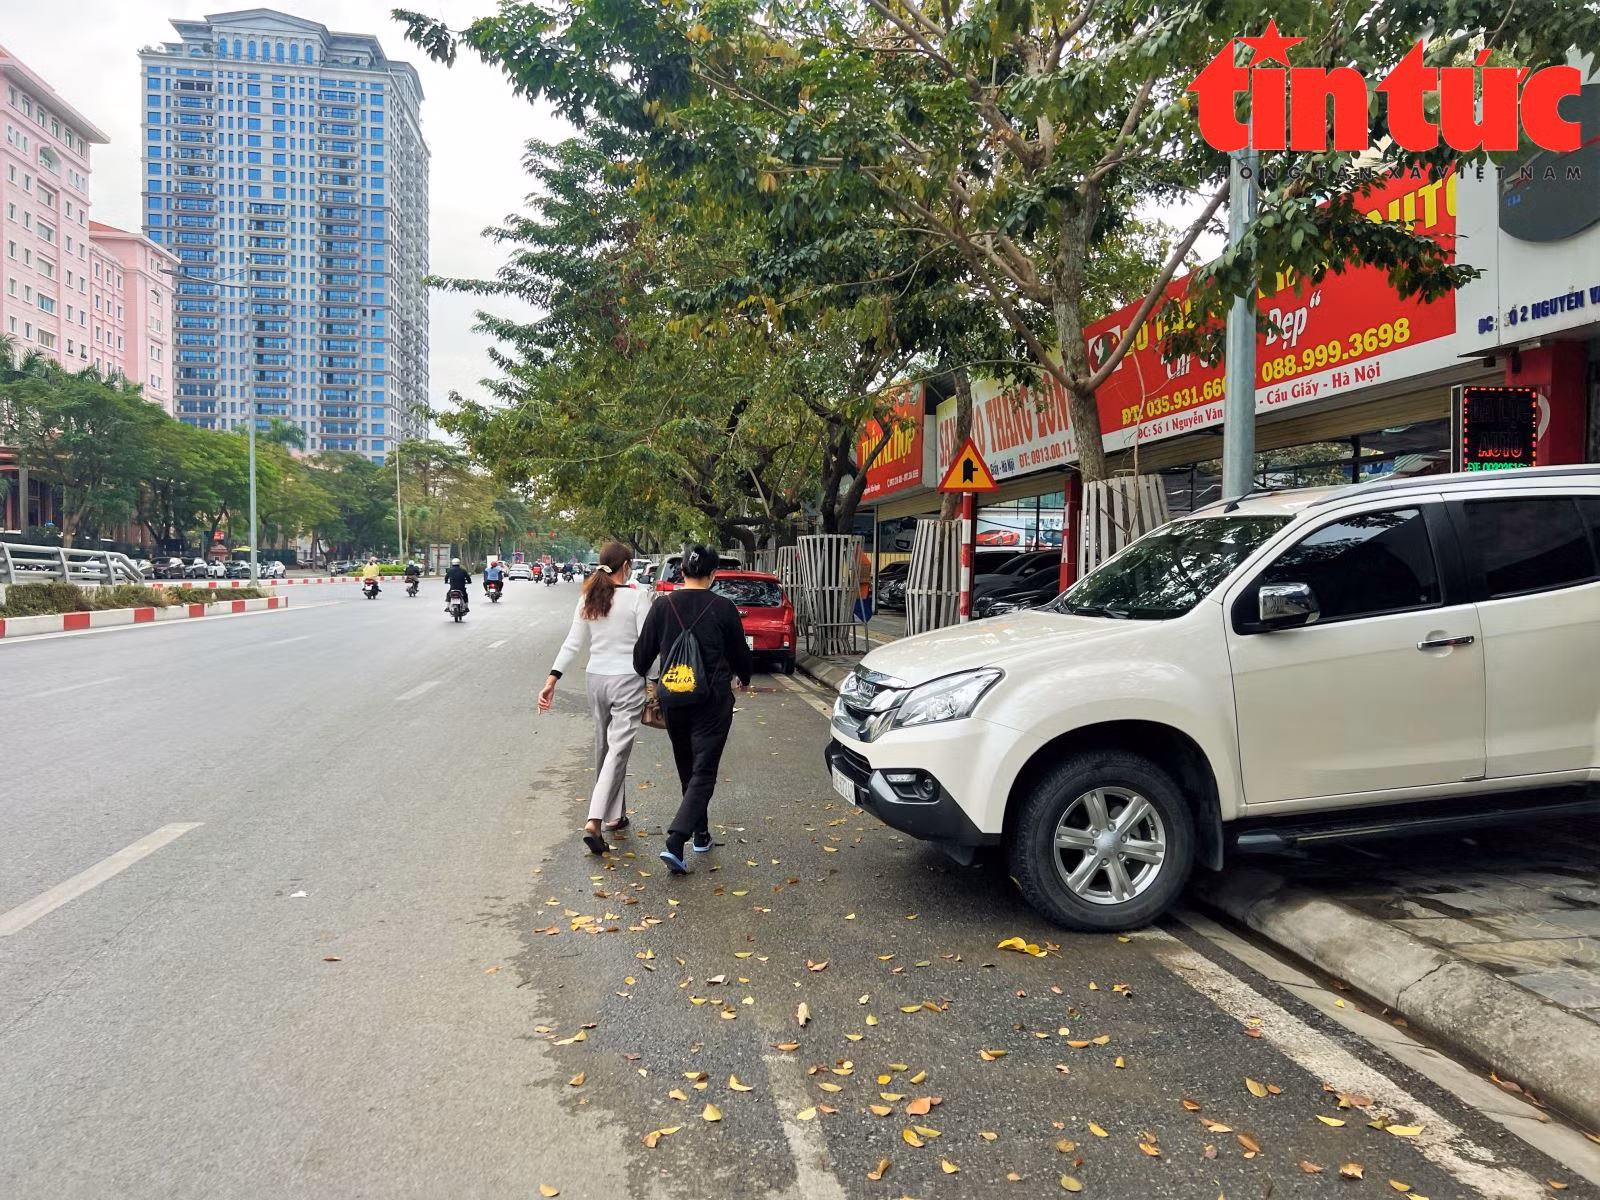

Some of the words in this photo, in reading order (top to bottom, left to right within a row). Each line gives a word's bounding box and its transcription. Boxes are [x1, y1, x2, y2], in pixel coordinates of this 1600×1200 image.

[1520, 305, 1529, 323] 2
[1034, 366, 1072, 438] LON
[1146, 376, 1227, 418] 035.931.66
[1261, 317, 1410, 383] 088.999.3698
[1172, 411, 1204, 431] Nguyễn
[1206, 407, 1224, 421] Văn
[1266, 388, 1288, 406] Cầu
[1291, 379, 1320, 399] Giấy
[1332, 371, 1351, 389] Hà
[1354, 361, 1381, 384] Nội
[1031, 439, 1078, 465] 0913.00.11.
